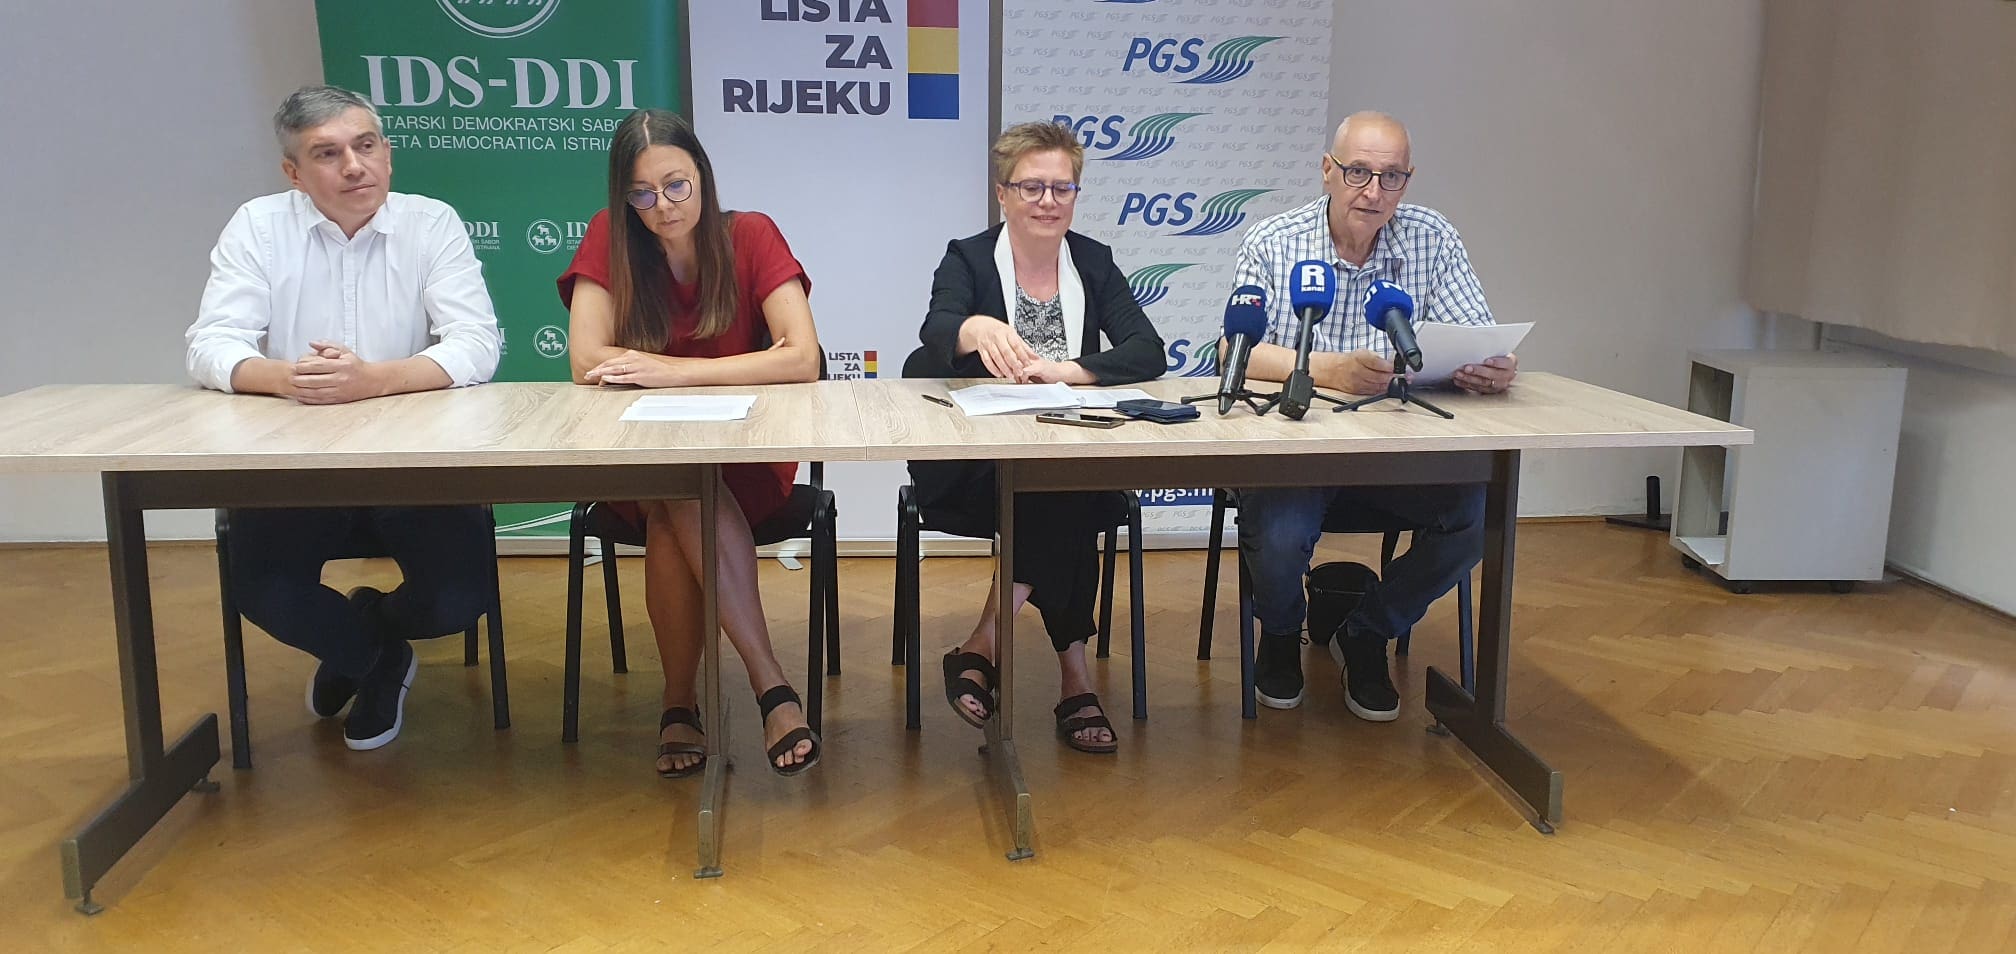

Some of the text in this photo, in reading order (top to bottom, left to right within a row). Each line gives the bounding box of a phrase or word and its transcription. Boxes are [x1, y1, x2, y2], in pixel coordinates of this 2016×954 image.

[760, 0, 892, 23] LISTA
[825, 34, 893, 70] ZA
[1122, 37, 1205, 74] PGS
[360, 55, 639, 110] IDS-DDI
[722, 78, 891, 116] RIJEKU
[382, 115, 623, 132] TARSKI DEMOKRATSKI SAB
[387, 134, 422, 149] ETA
[428, 135, 556, 151] DEMOCRATICA
[1117, 191, 1197, 227] PGS
[1301, 264, 1325, 286] R
[829, 352, 861, 361] LISTA
[844, 363, 861, 372] ZA
